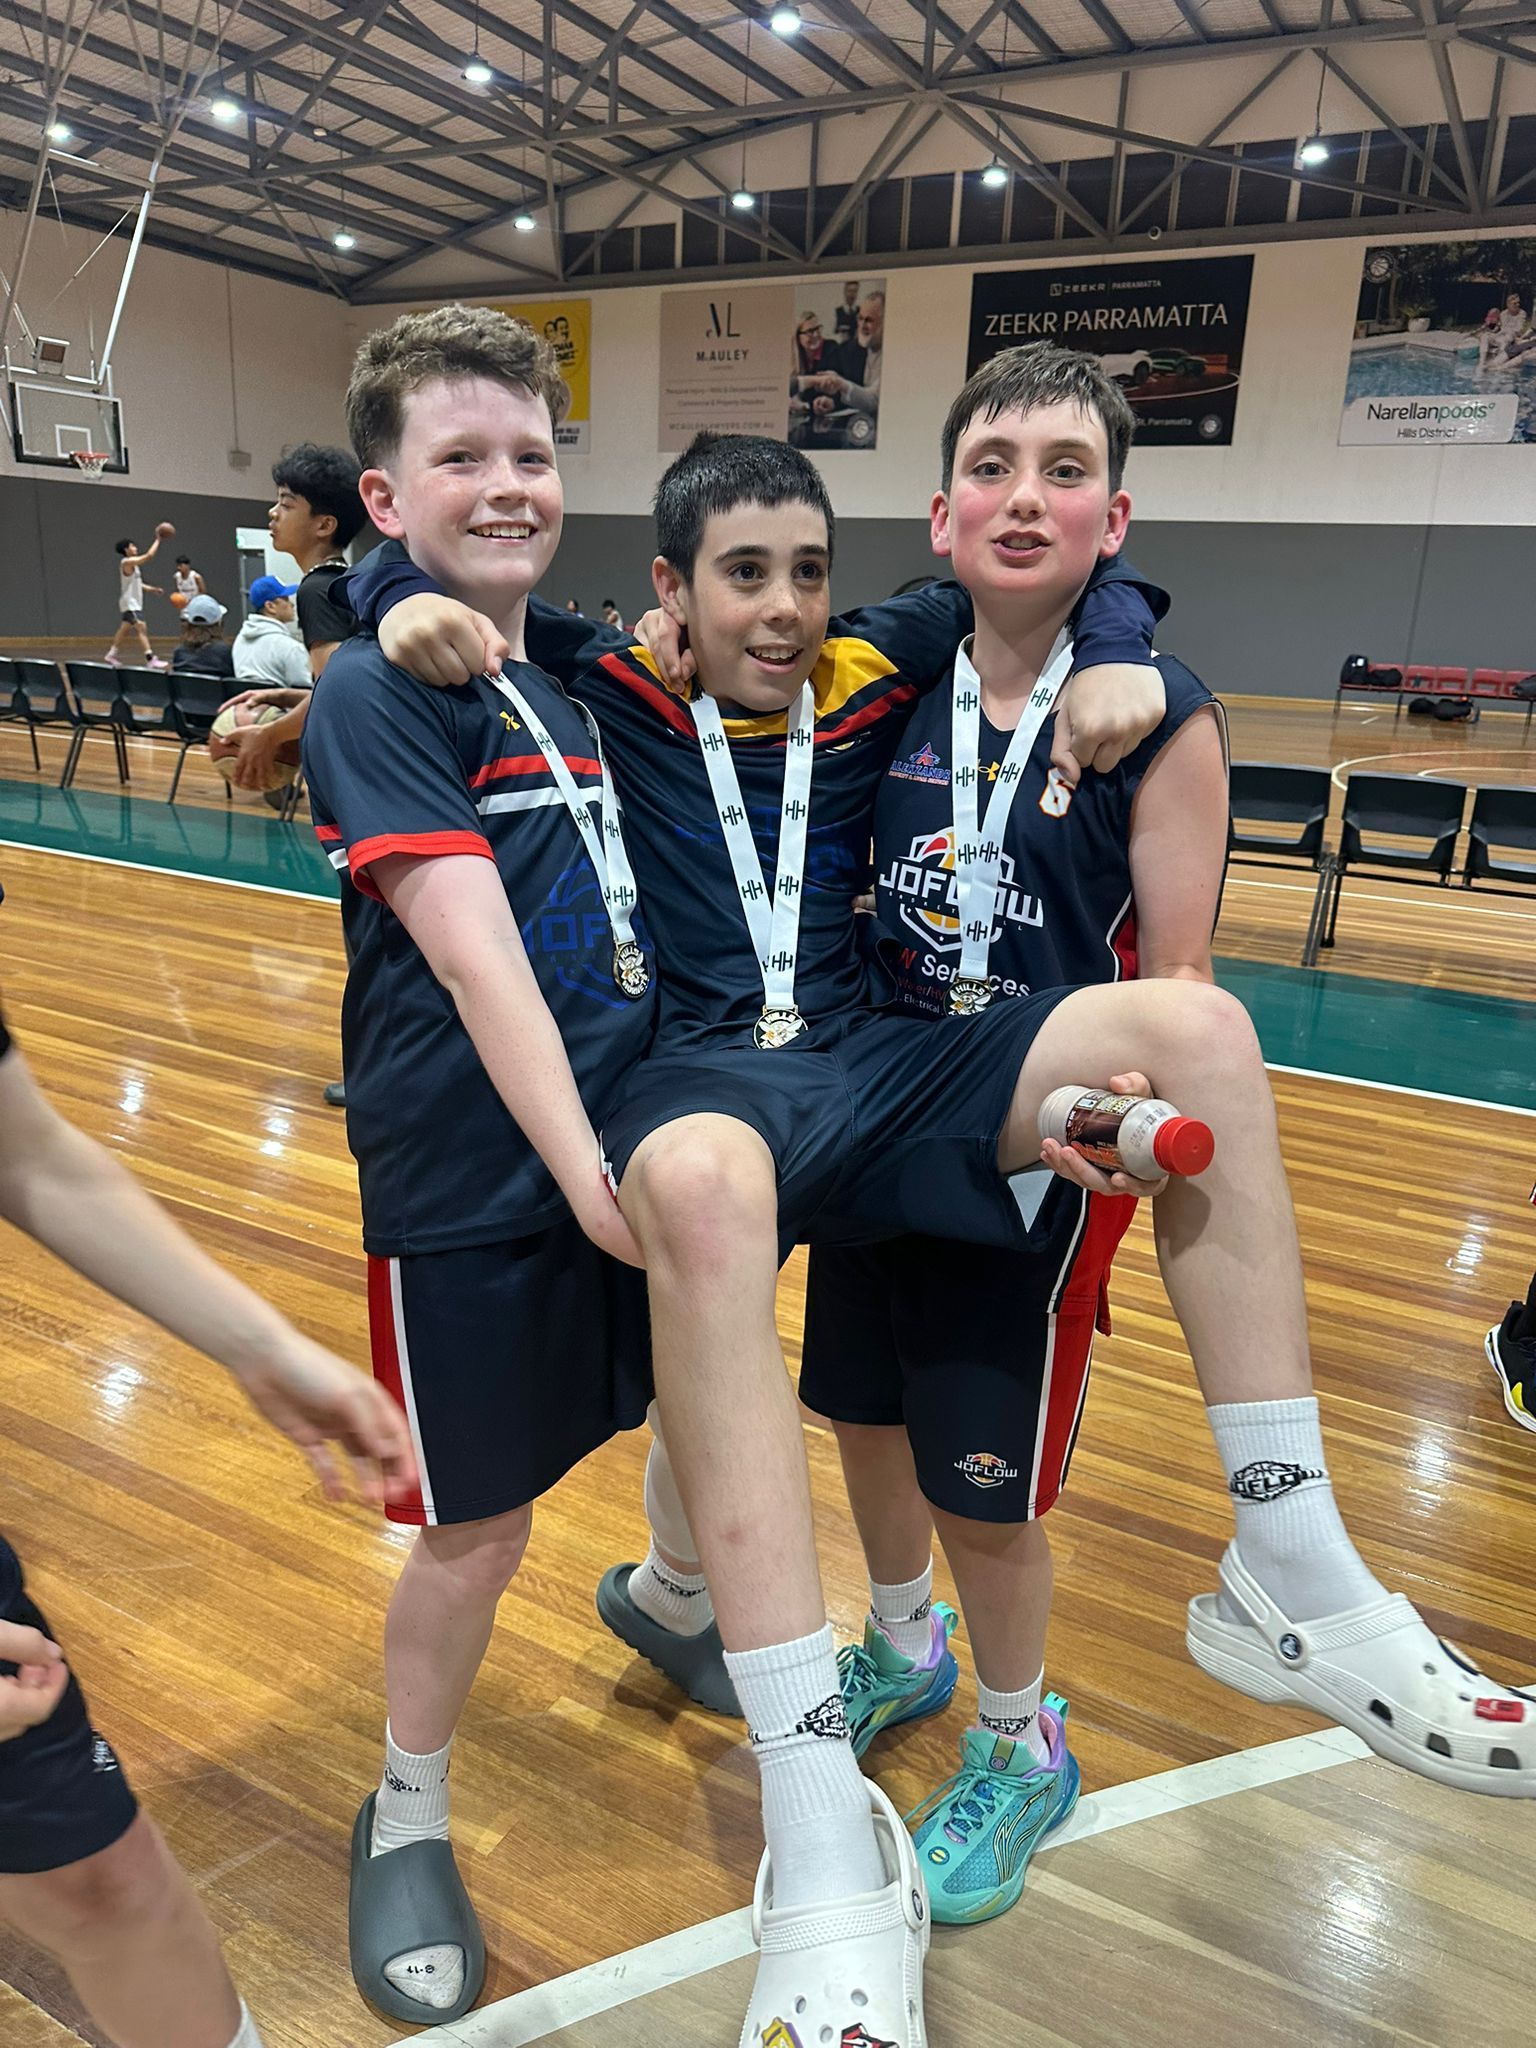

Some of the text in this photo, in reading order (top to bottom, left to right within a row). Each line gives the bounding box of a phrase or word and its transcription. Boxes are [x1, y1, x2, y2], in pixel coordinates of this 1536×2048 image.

[1064, 283, 1106, 294] ZEEKR
[984, 303, 1229, 336] ZEEKR PARRAMATTA
[1367, 402, 1488, 424] Narellanpools
[1397, 427, 1457, 438] Hills District
[921, 953, 1031, 997] Serces
[955, 982, 985, 995] HILLS
[953, 1460, 1018, 1478] JOFLOW
